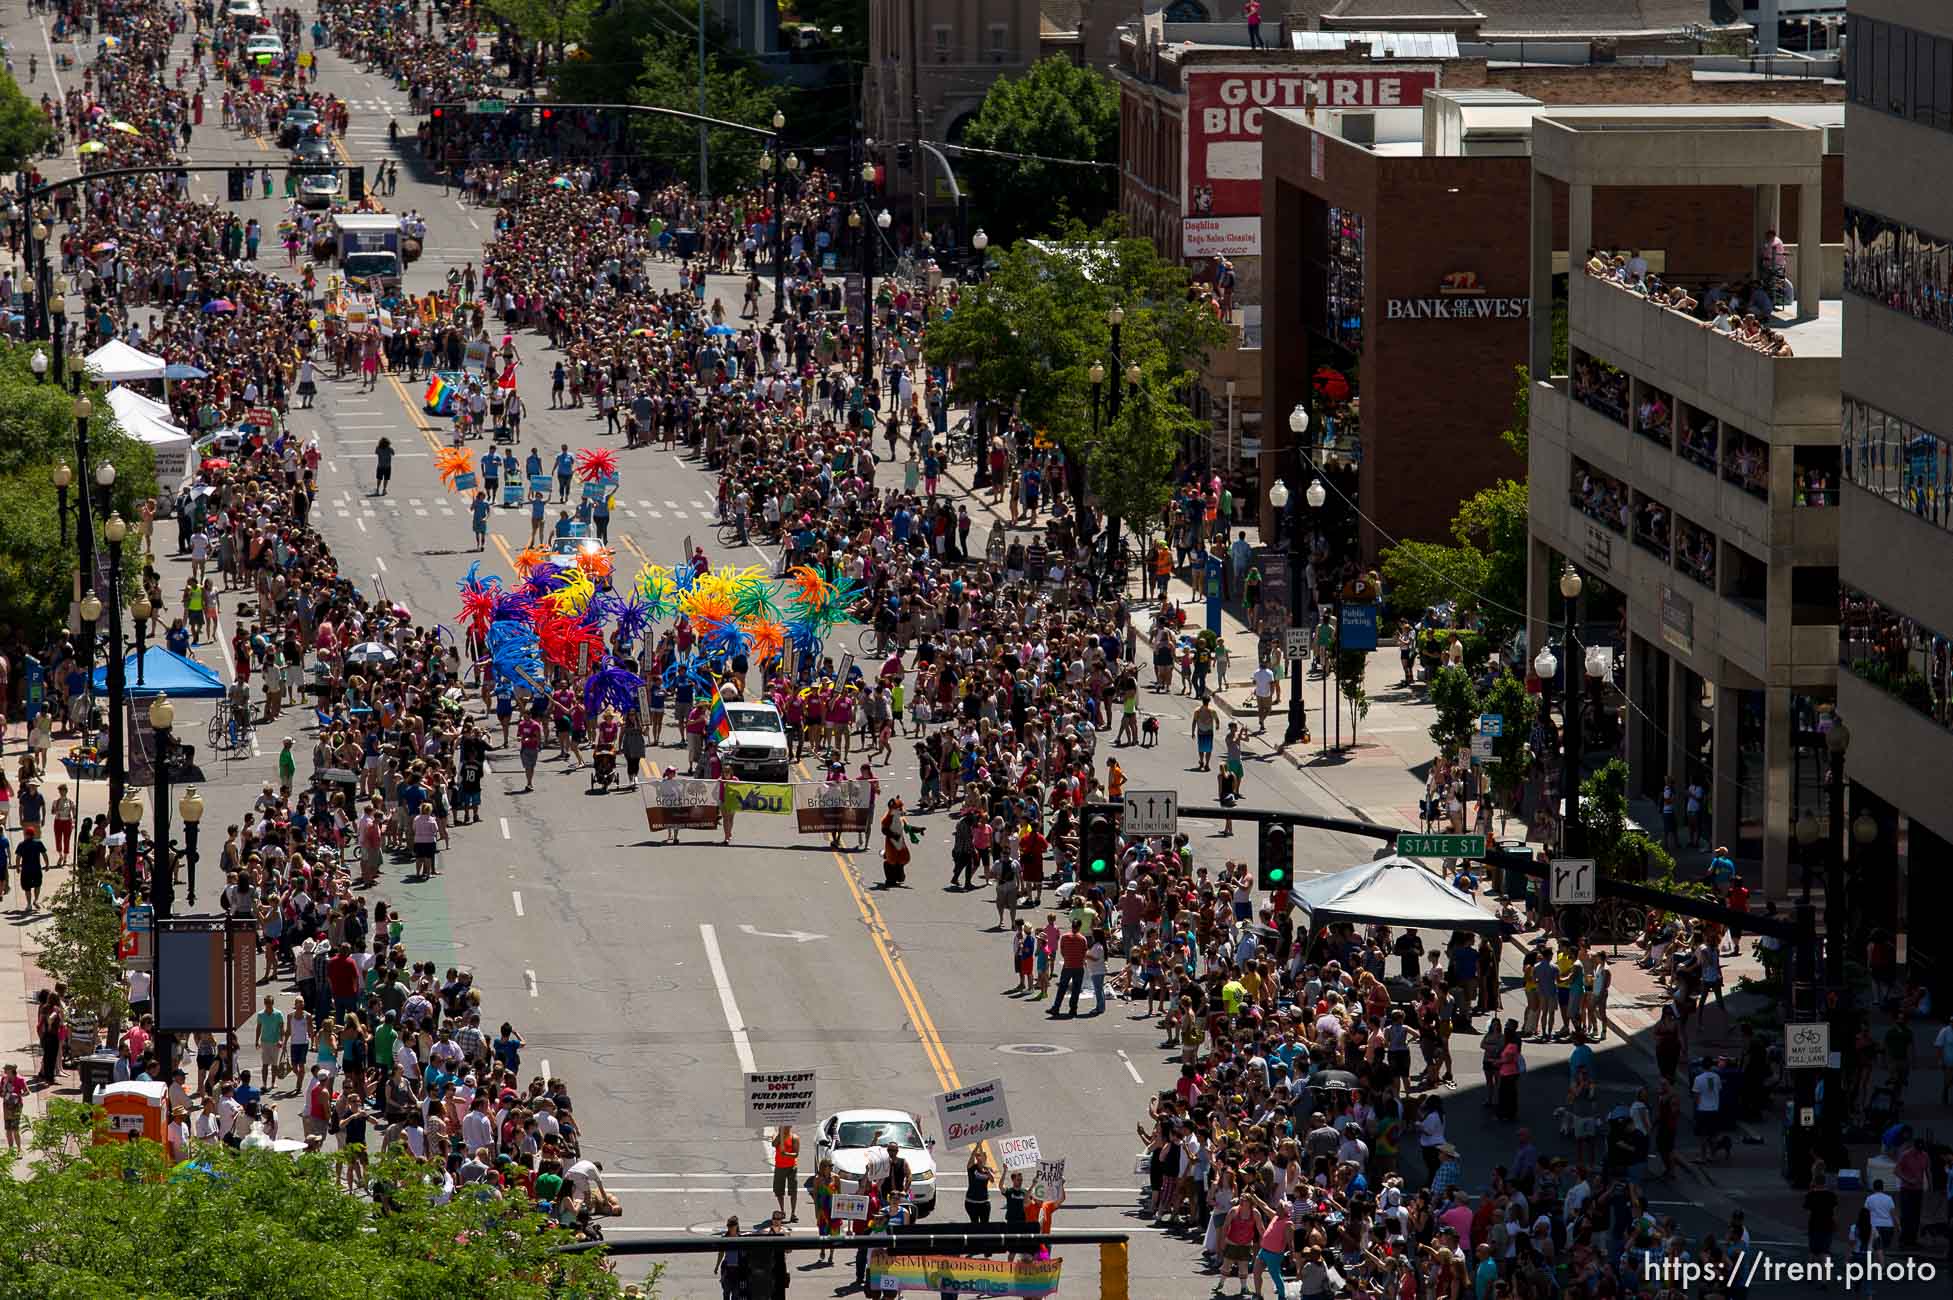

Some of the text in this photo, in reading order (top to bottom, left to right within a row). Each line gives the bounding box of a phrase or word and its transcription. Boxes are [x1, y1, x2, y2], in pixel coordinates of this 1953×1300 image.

[1220, 78, 1401, 105] GUTHRIE
[1386, 299, 1534, 318] BANK OF THE WEST
[1355, 582, 1365, 593] P
[1288, 645, 1308, 657] 25
[466, 770, 476, 782] 18
[1405, 839, 1477, 853] STATE ST
[240, 944, 250, 1012] DOWNTOWN
[768, 1083, 796, 1091] DON'T
[945, 1084, 994, 1102] Life without
[752, 1091, 814, 1100] BUILD BRIDGES
[753, 1102, 764, 1110] TO
[948, 1118, 1004, 1140] Divine
[1001, 1138, 1036, 1154] LOVE ONE
[1004, 1151, 1040, 1168] ANOTHER
[1040, 1158, 1065, 1172] THIS
[978, 1260, 1004, 1273] and
[883, 1279, 895, 1289] 92
